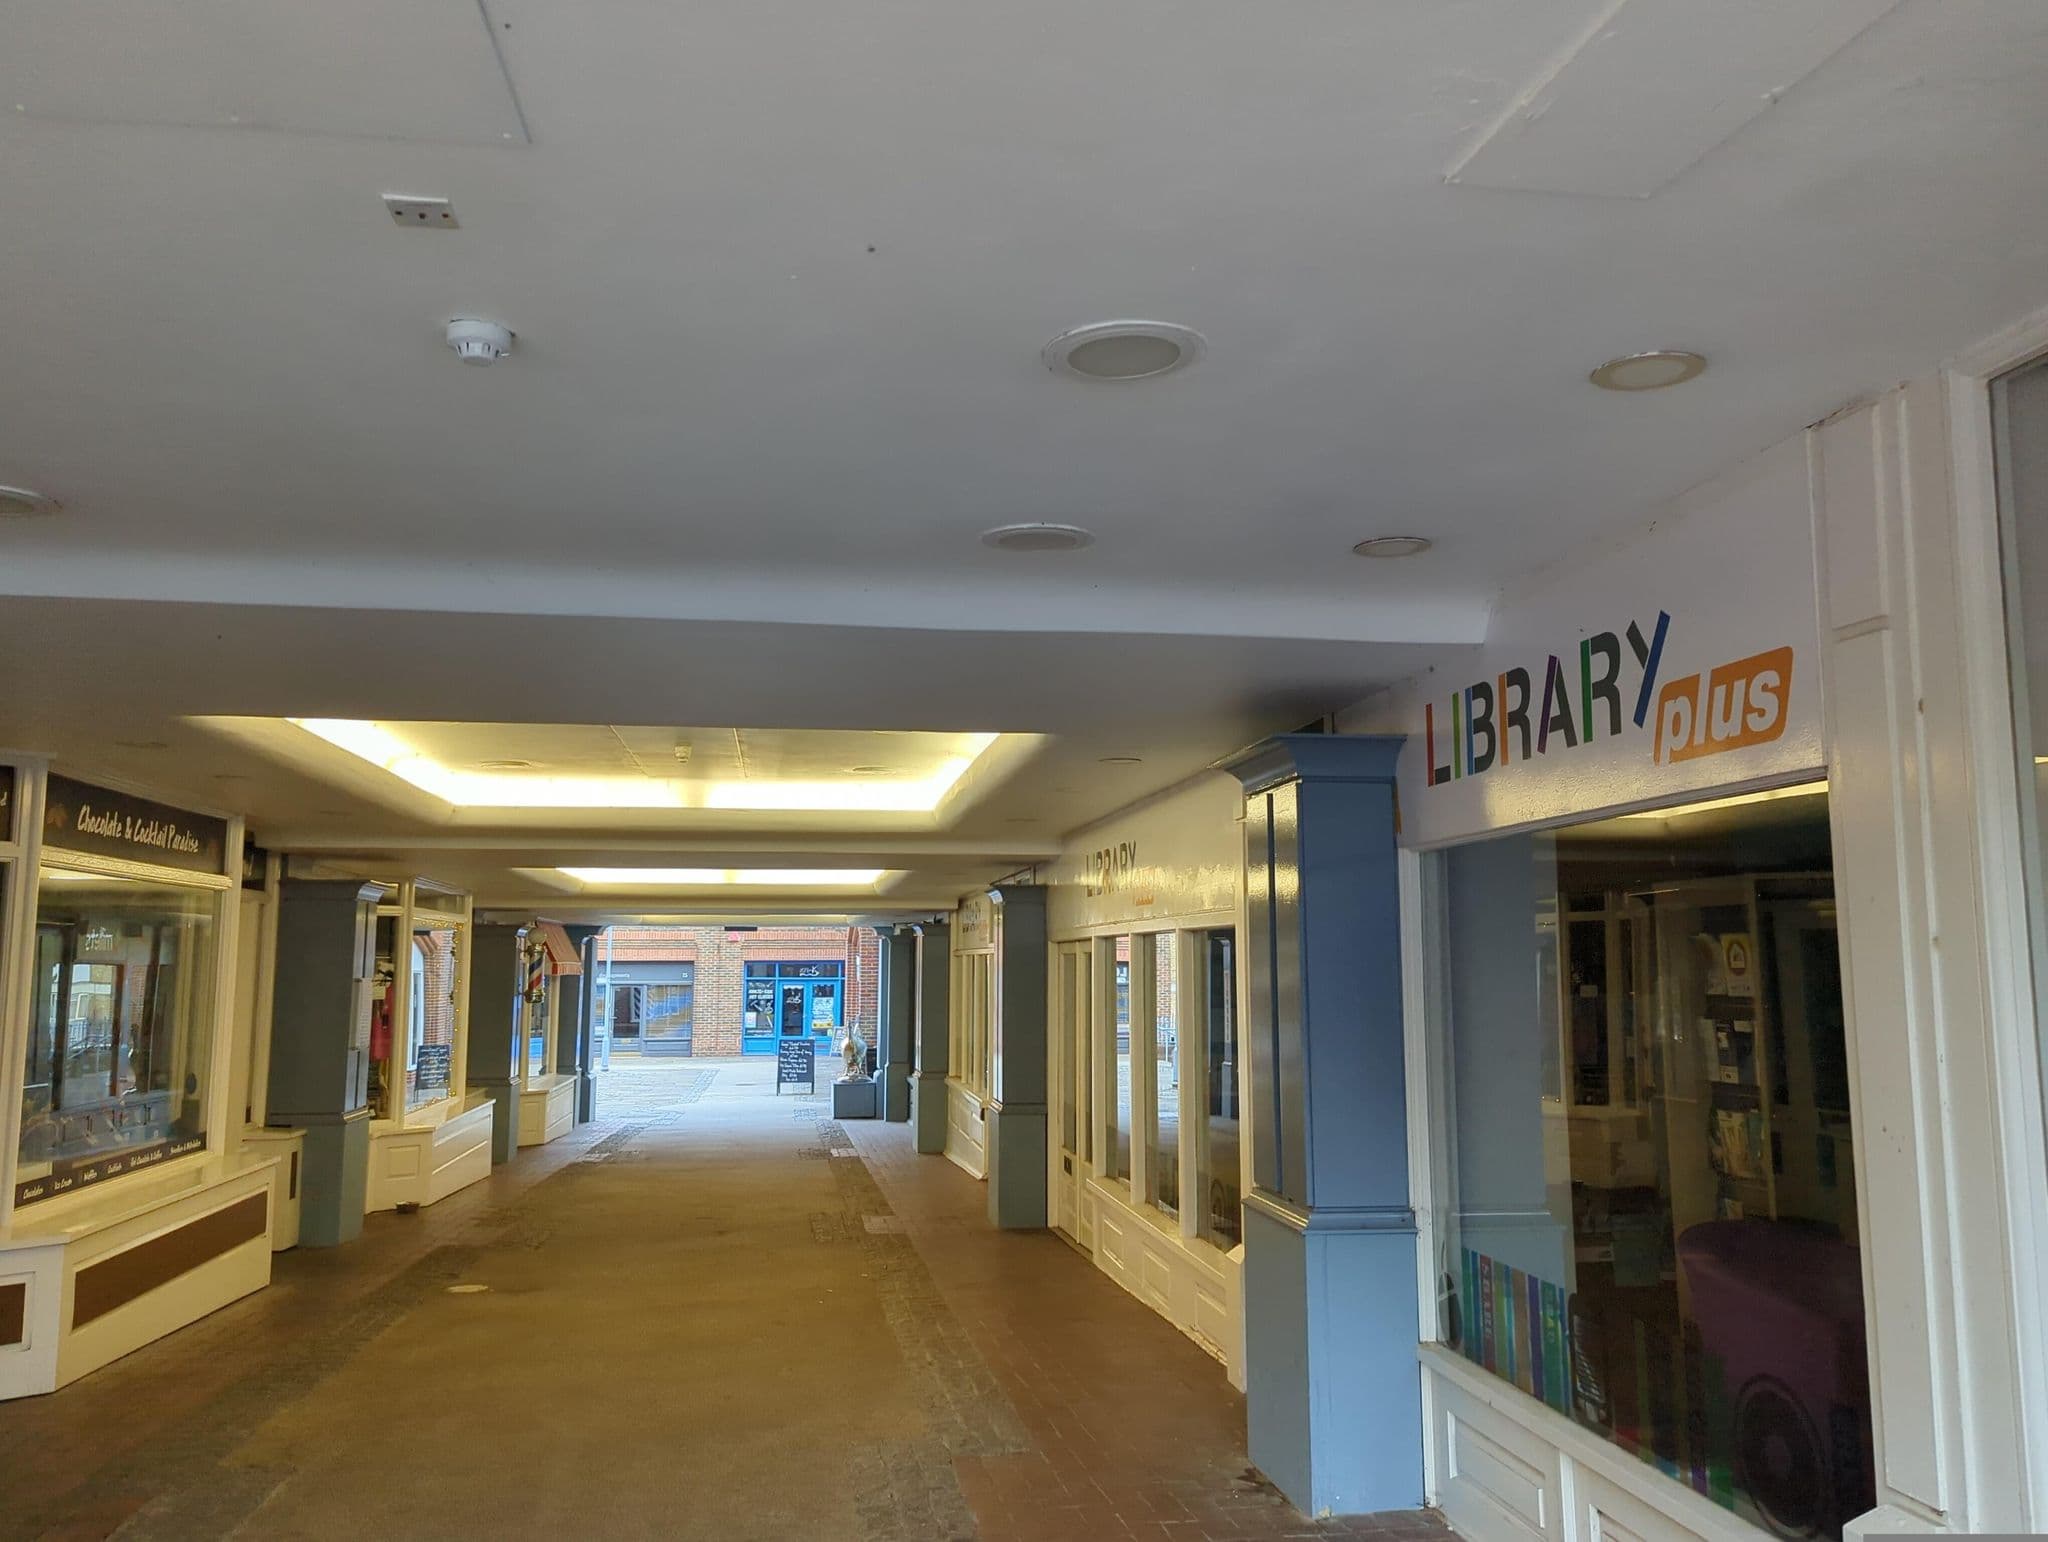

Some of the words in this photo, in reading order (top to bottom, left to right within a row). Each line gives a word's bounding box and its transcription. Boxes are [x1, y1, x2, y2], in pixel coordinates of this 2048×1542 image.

[1425, 610, 1670, 787] LIBRARY
[1655, 660, 1786, 767] plus
[77, 804, 122, 839] Chocolate
[124, 815, 132, 841] &
[133, 818, 167, 849] Cocktail
[167, 824, 199, 854] Paradise
[1086, 840, 1136, 897] LIBRARY
